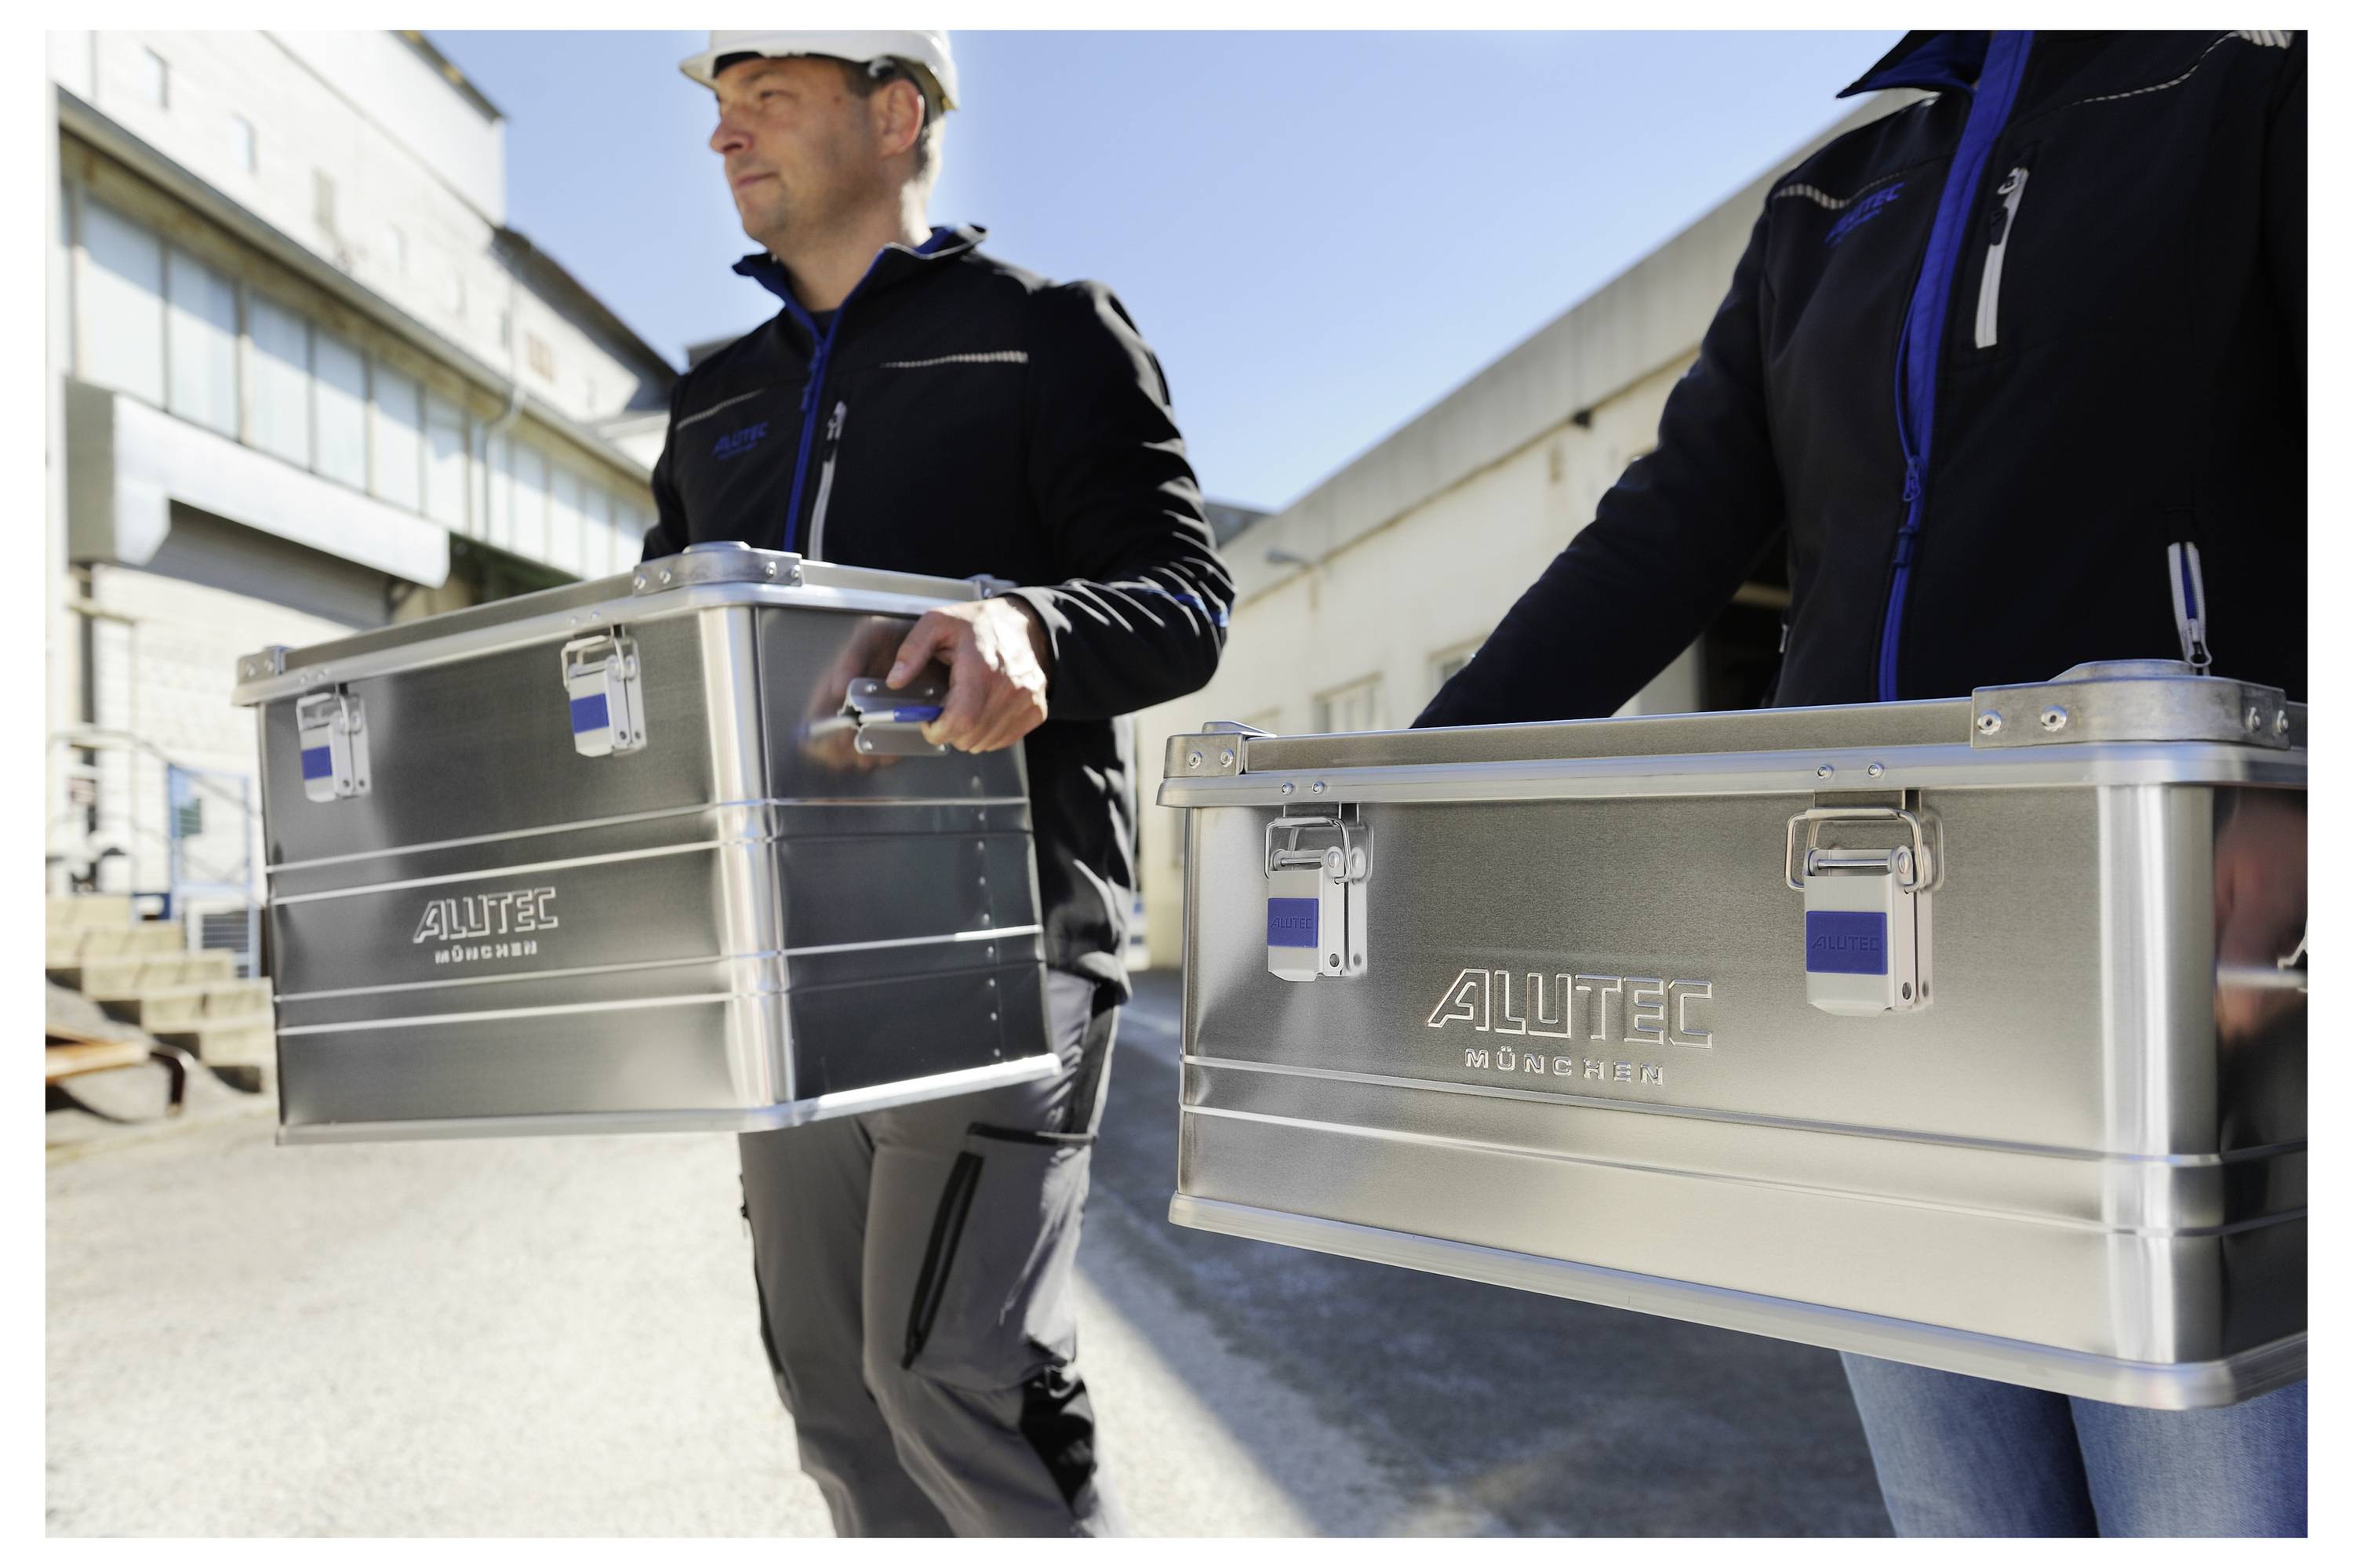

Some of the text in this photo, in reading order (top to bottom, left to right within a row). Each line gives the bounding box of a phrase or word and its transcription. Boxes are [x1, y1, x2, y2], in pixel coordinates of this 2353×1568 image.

[413, 886, 558, 944] ALUTEC
[1271, 917, 1312, 930] ALUTEC
[435, 940, 538, 965] MÜNCHEN
[1812, 935, 1879, 951] ALUTEC
[1427, 968, 1713, 1049] ALUTEC
[1464, 1045, 1664, 1086] MÜNCHEN
